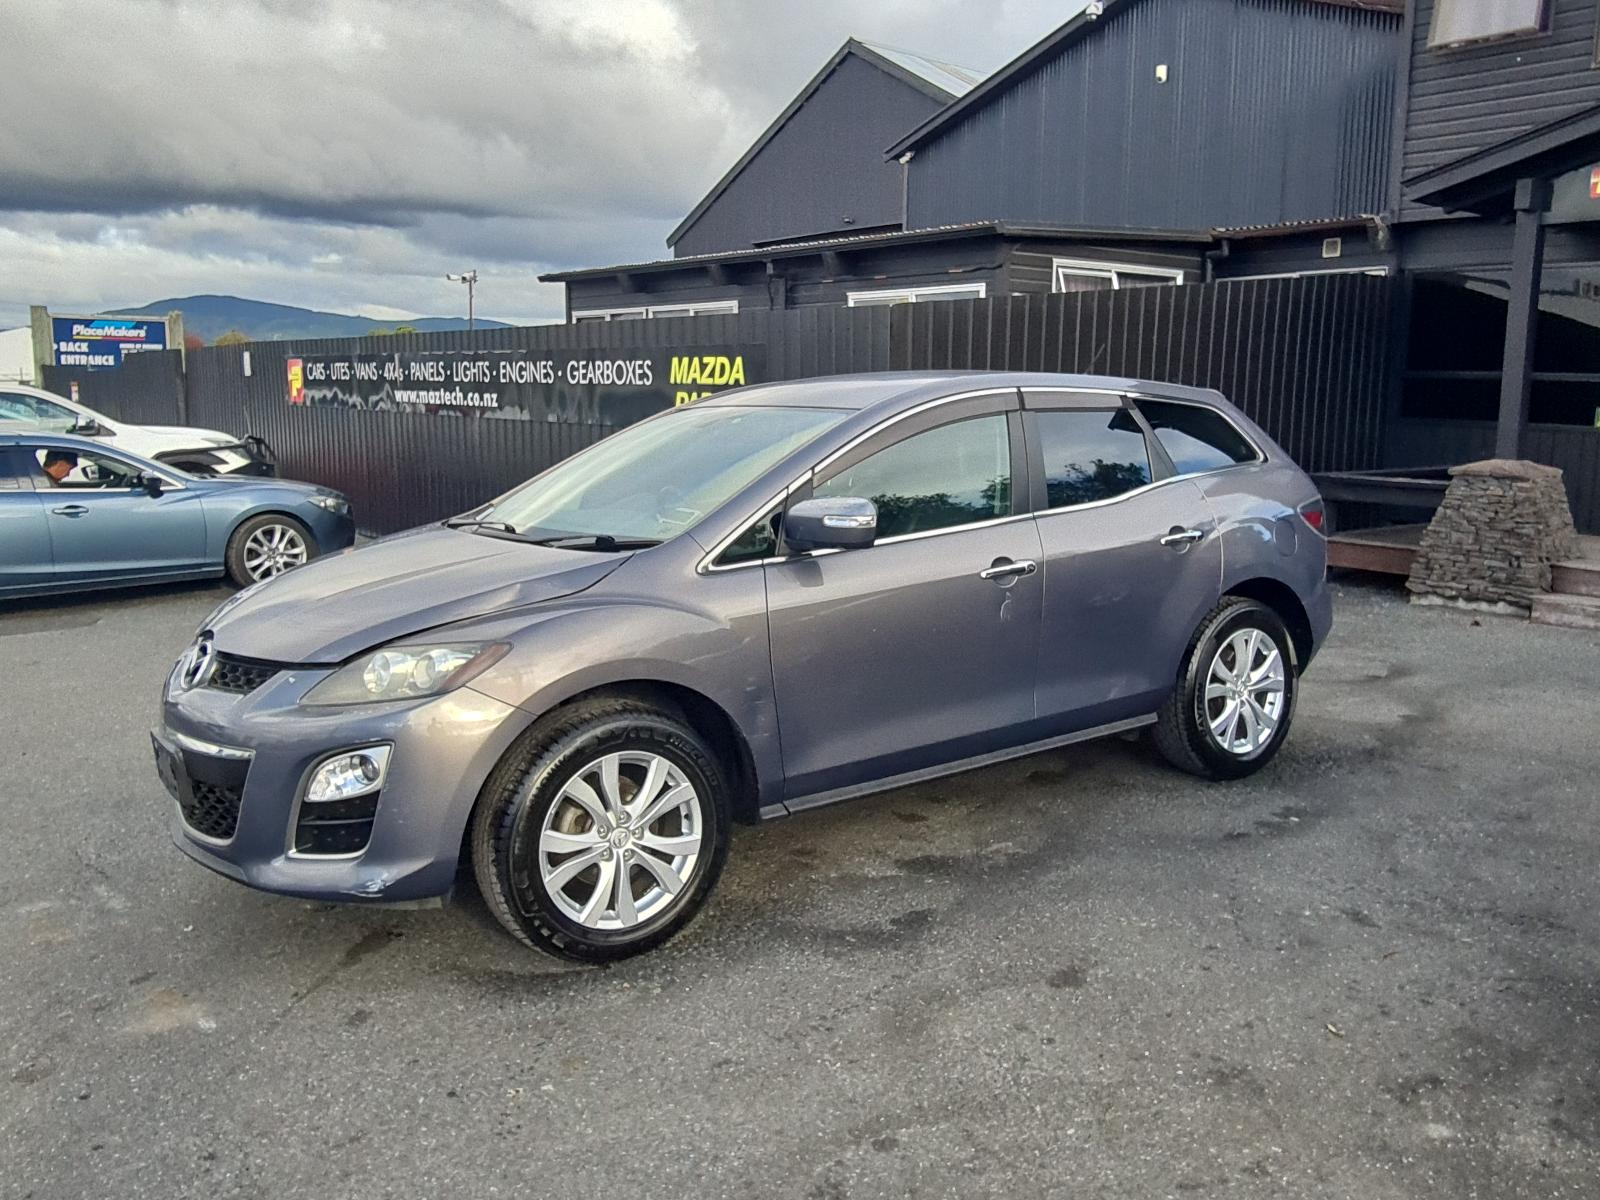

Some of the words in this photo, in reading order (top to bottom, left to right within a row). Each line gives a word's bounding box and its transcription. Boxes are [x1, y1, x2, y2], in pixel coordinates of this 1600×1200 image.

[72, 324, 146, 338] PlaceMakers
[59, 341, 89, 353] BACK
[60, 354, 115, 366] ENTRANCE
[306, 362, 326, 380] CARS
[330, 362, 350, 381] UTES
[354, 362, 378, 381] VANS
[410, 361, 446, 382] PANELS
[453, 360, 491, 383] LIGHTS
[500, 360, 554, 384] ENGINES
[566, 360, 653, 386] GEARBOXES
[669, 356, 746, 385] MAZDA
[394, 386, 498, 408] www.maztech.co.nz
